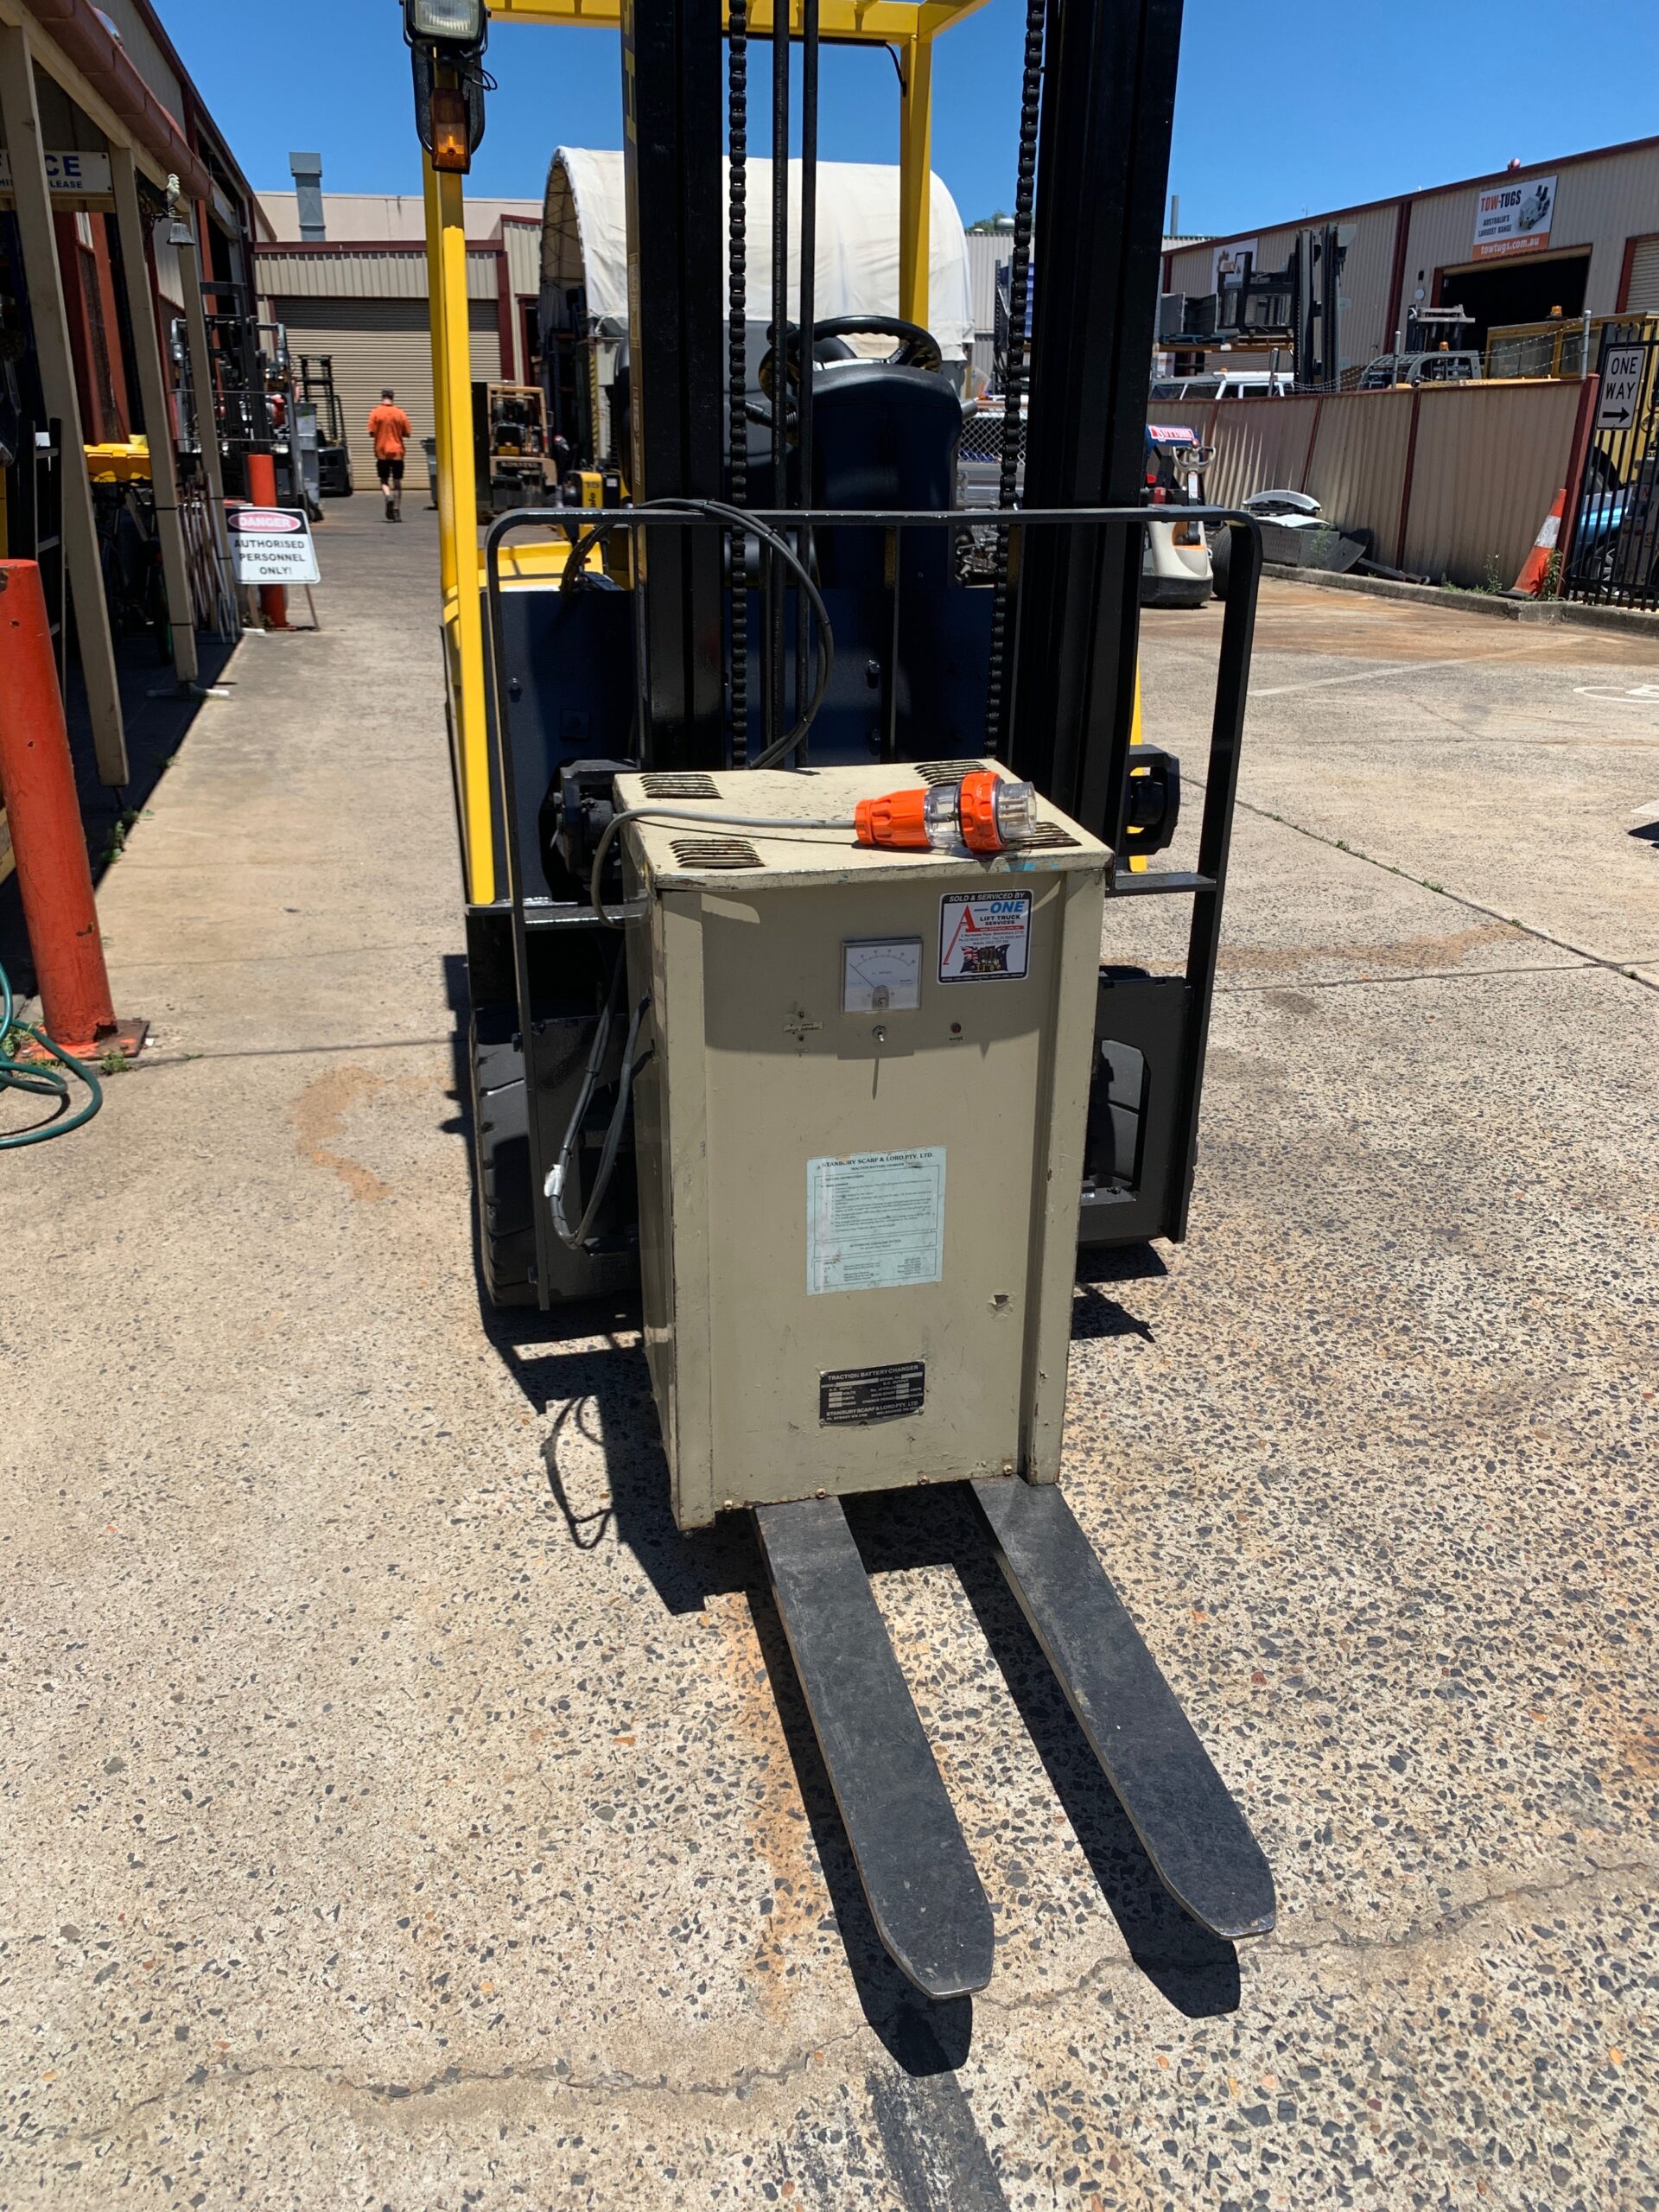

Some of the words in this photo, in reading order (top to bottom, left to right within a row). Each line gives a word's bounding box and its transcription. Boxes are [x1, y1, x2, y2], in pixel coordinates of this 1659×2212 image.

[49, 180, 83, 188] LEASE
[1480, 189, 1522, 213] TOW-TUGS
[1497, 225, 1512, 234] RANGE
[1480, 237, 1540, 255] towtugs.com.au
[1611, 356, 1639, 375] ONE
[1605, 381, 1636, 400] WAY
[239, 517, 290, 528] DANGER
[234, 539, 305, 549] AUTHORISED
[238, 553, 307, 562] PERSONNEL
[259, 566, 293, 575] ONLY!
[949, 894, 969, 903] SOLD
[976, 893, 1014, 901] SERVICED
[828, 1373, 860, 1382] TRACTION
[861, 1370, 888, 1378] BATTERY
[888, 1364, 918, 1374] CHARGER
